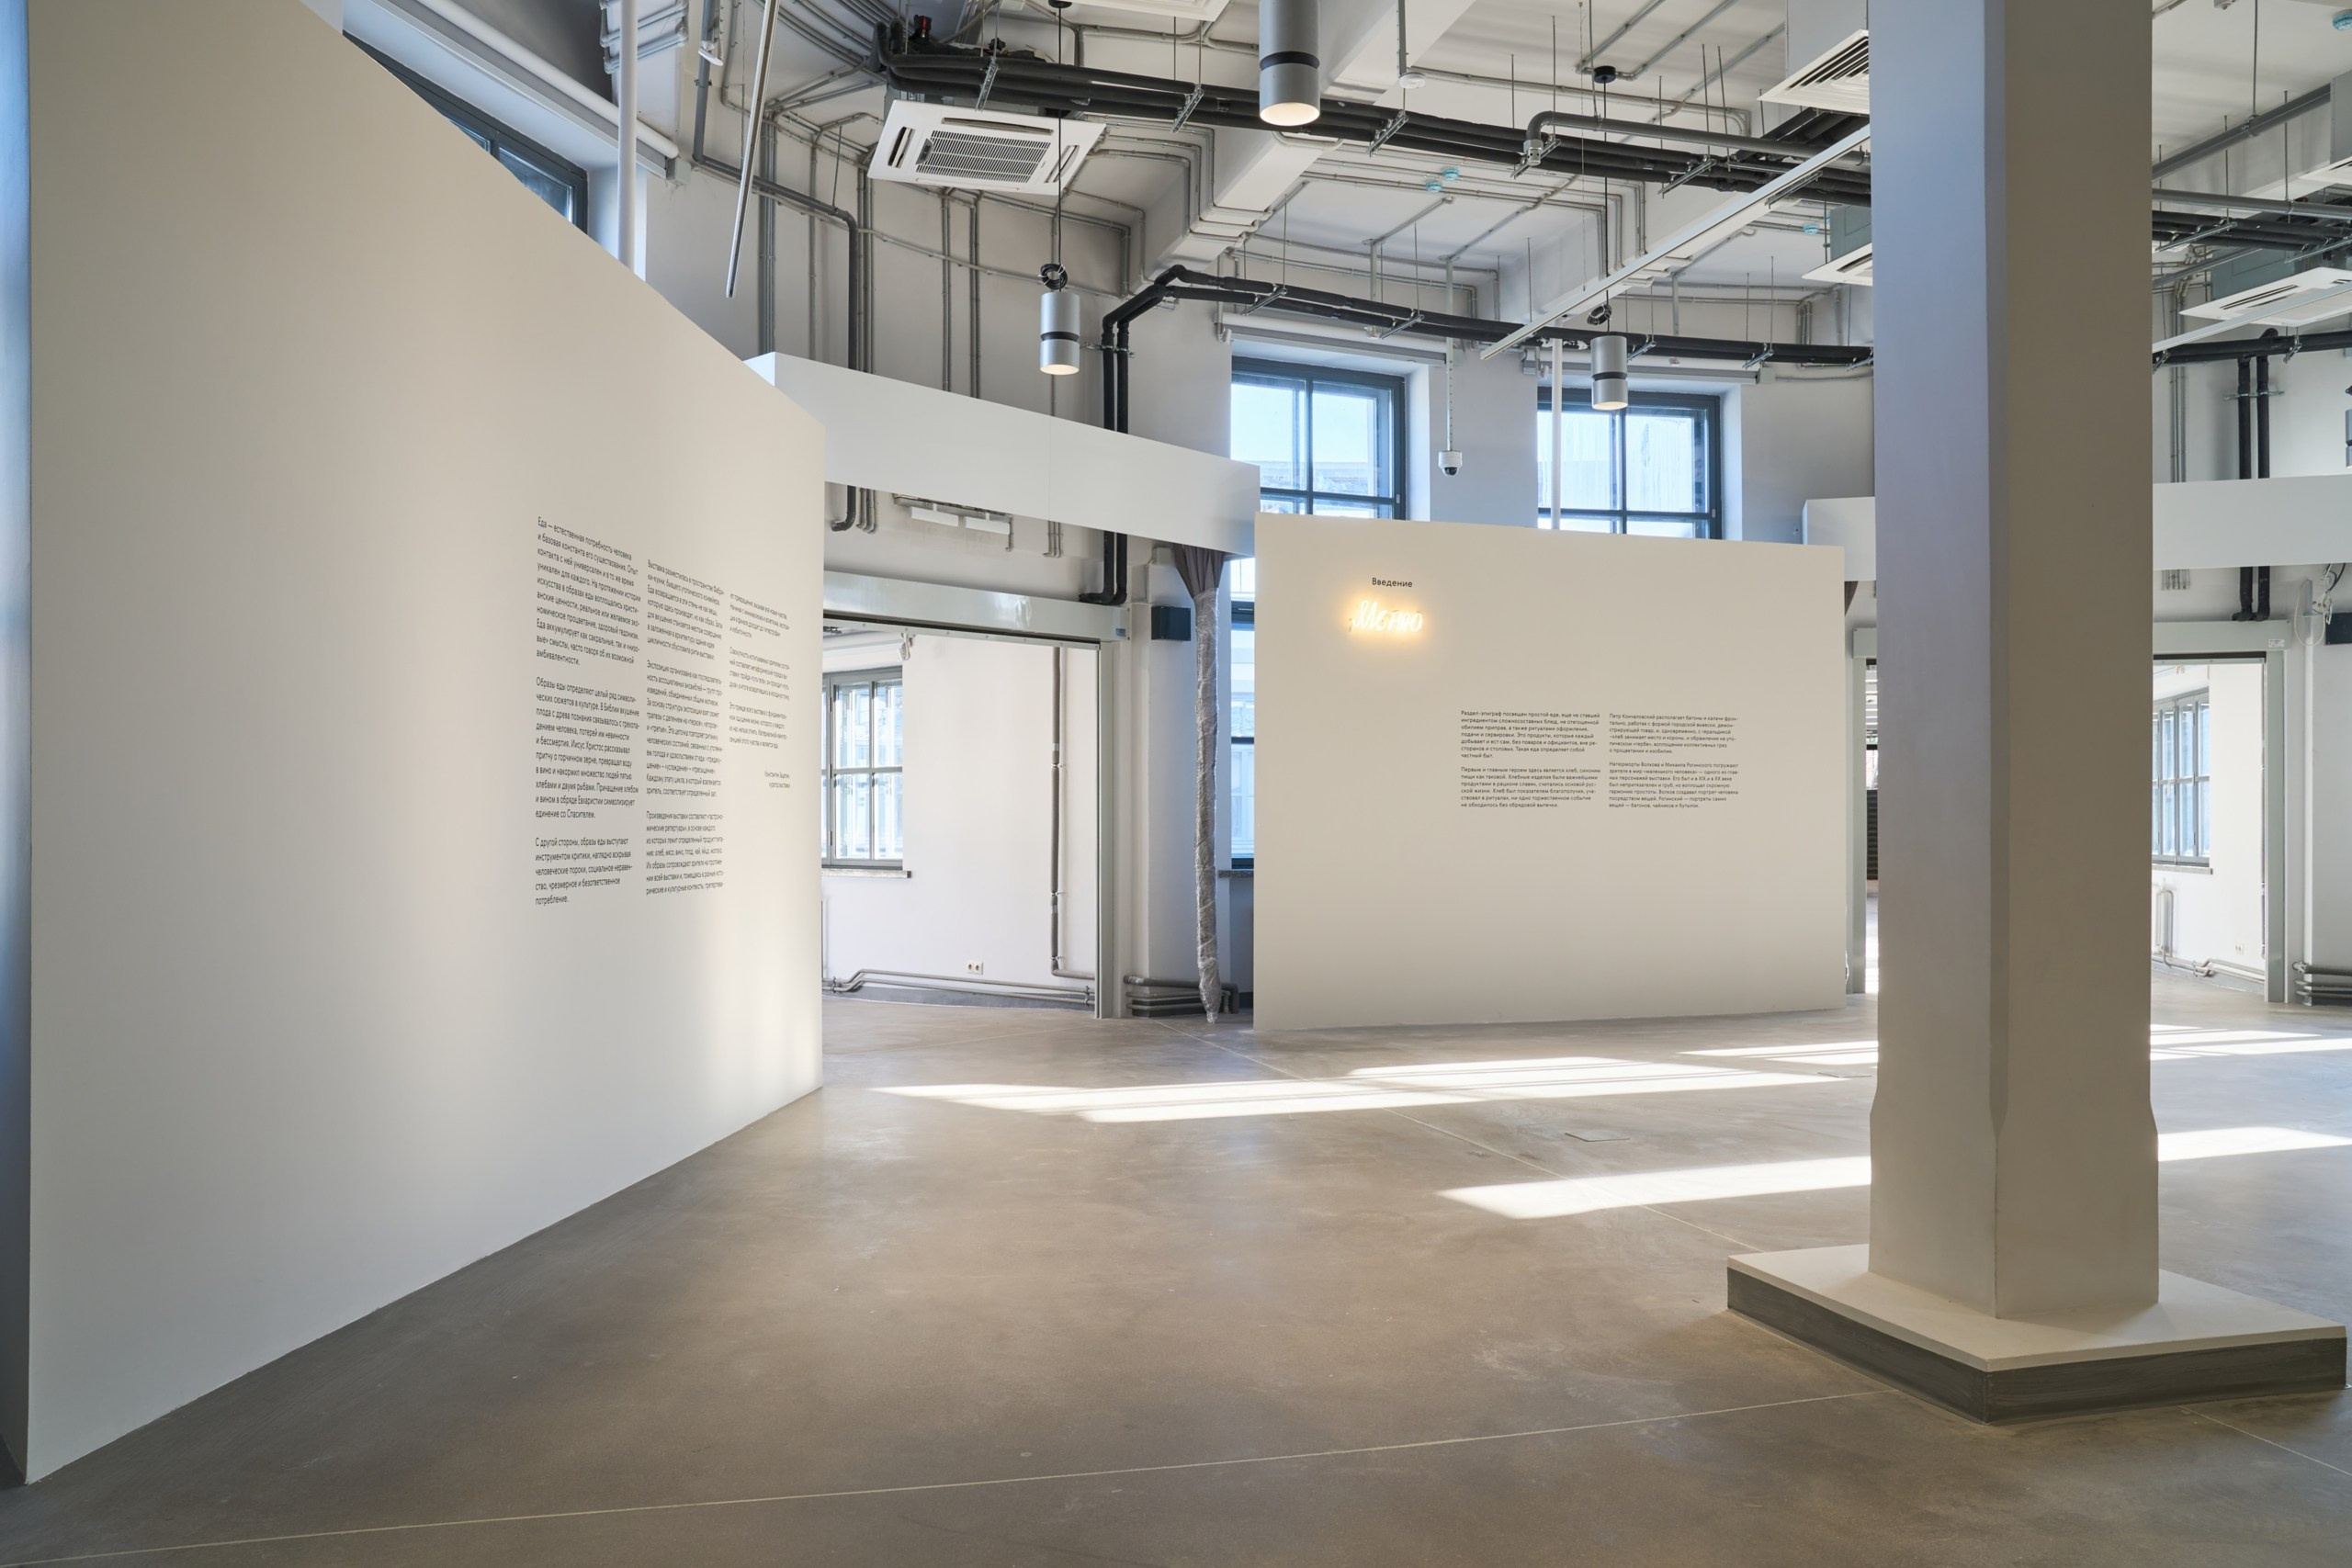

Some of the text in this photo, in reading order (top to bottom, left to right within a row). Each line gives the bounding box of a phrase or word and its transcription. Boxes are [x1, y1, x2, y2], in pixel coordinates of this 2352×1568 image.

[538, 516, 547, 529] Еда
[554, 525, 585, 542] естественная
[585, 537, 613, 554] потребность
[537, 562, 560, 576] уникален
[561, 570, 570, 579] для
[571, 574, 590, 586] каждого.
[1372, 577, 1413, 588] Введение
[537, 577, 561, 591] искусства
[566, 585, 584, 597] образах
[585, 592, 594, 601] еды
[595, 595, 623, 609] воплощались
[537, 591, 554, 603] анские
[555, 597, 578, 610] ценности,
[579, 604, 601, 616] реальное
[537, 606, 566, 620] номическое
[567, 614, 596, 629] процветание,
[549, 638, 569, 650] смыслы,
[571, 644, 583, 653] часто
[584, 646, 599, 657] говоря
[536, 649, 580, 666] амбивалентности.
[536, 676, 555, 689] Образы
[556, 683, 566, 691] еды
[567, 685, 594, 696] определяют
[595, 690, 609, 698] целый
[536, 722, 555, 732] дением
[556, 726, 578, 735] человека,
[579, 728, 598, 738] потерей
[540, 736, 569, 748] бессмертия.
[571, 739, 585, 751] Иисус
[586, 741, 604, 752] Христос
[536, 752, 553, 762] притчу
[558, 754, 583, 763] горчичном
[584, 756, 597, 766] зерне,
[536, 779, 557, 789] хлебами
[562, 783, 576, 792] двумя
[577, 782, 595, 792] рыбами.
[596, 782, 623, 793] Причащение
[535, 810, 560, 819] единение
[567, 809, 595, 818] Спасителем.
[540, 837, 558, 849] другой
[558, 839, 579, 848] стороны,
[580, 837, 597, 847] образы
[535, 853, 571, 863] инструментом
[571, 853, 591, 862] критики,
[536, 867, 569, 876] человеческие
[569, 867, 587, 876] пороки,
[588, 865, 614, 873] социальное
[549, 881, 577, 891] чрезмерное
[582, 878, 620, 887] безответственное
[535, 894, 568, 907] потребление.
